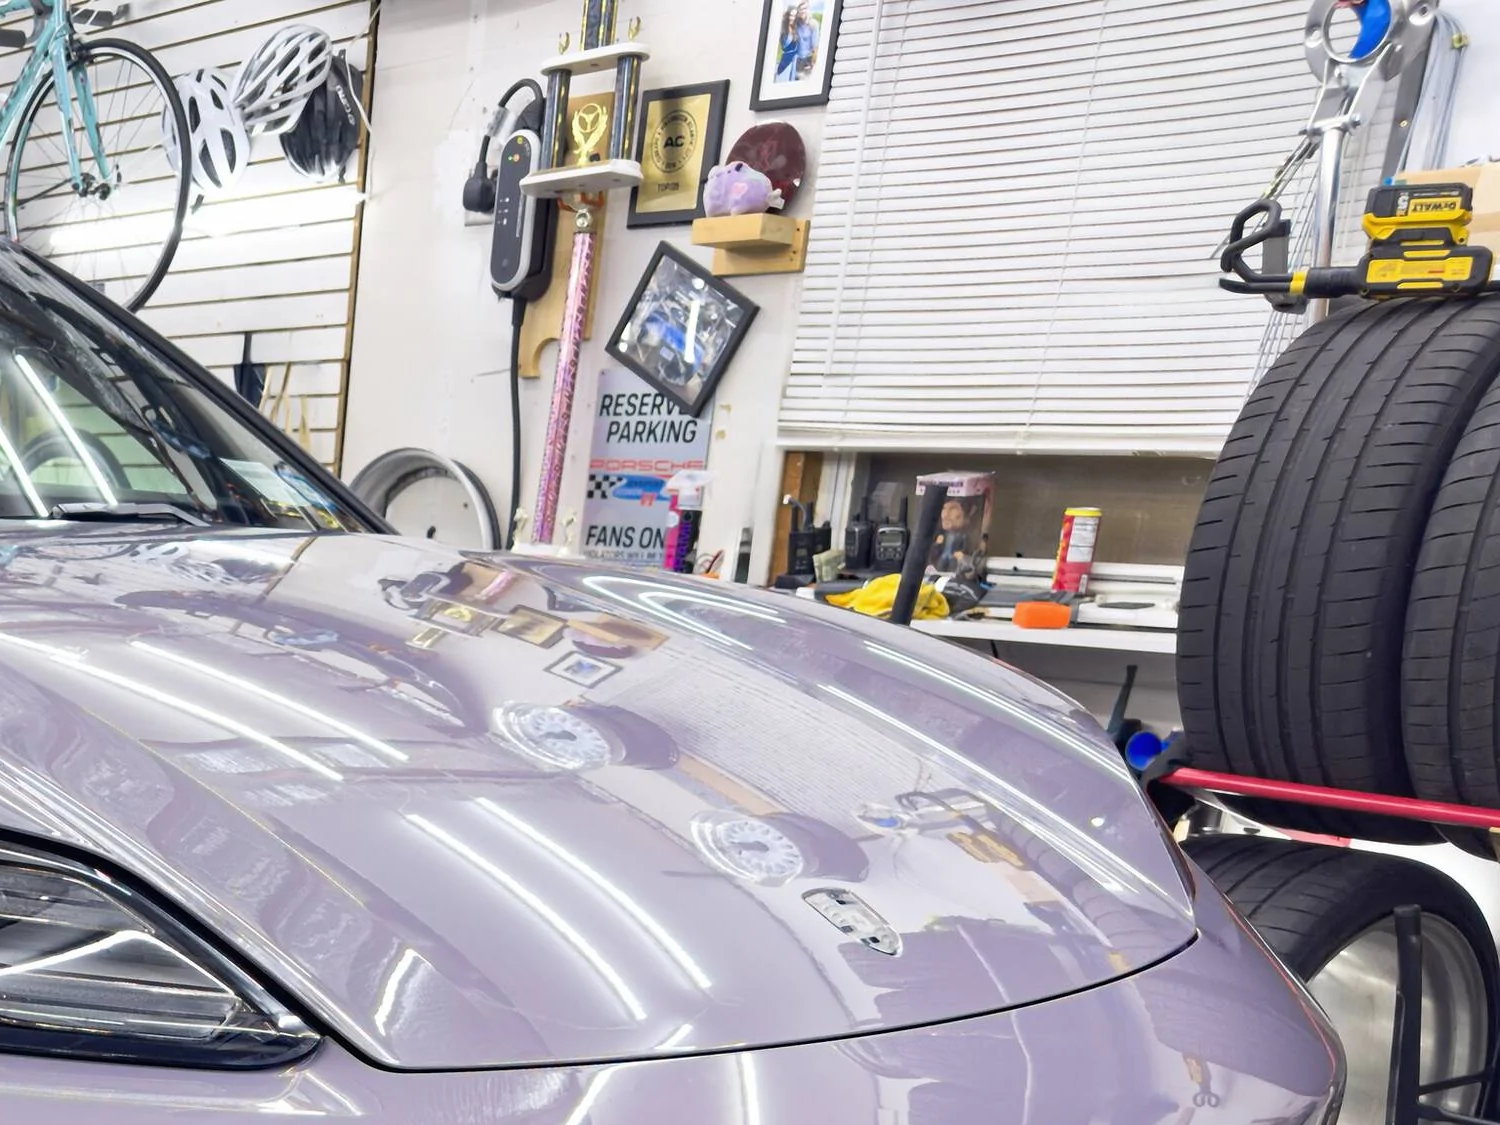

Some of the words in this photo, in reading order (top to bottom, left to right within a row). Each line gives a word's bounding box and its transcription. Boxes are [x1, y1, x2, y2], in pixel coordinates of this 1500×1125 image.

[599, 393, 689, 416] RESERV
[606, 421, 698, 443] PARKING
[590, 460, 704, 472] PORSCHE
[585, 525, 636, 548] FANS
